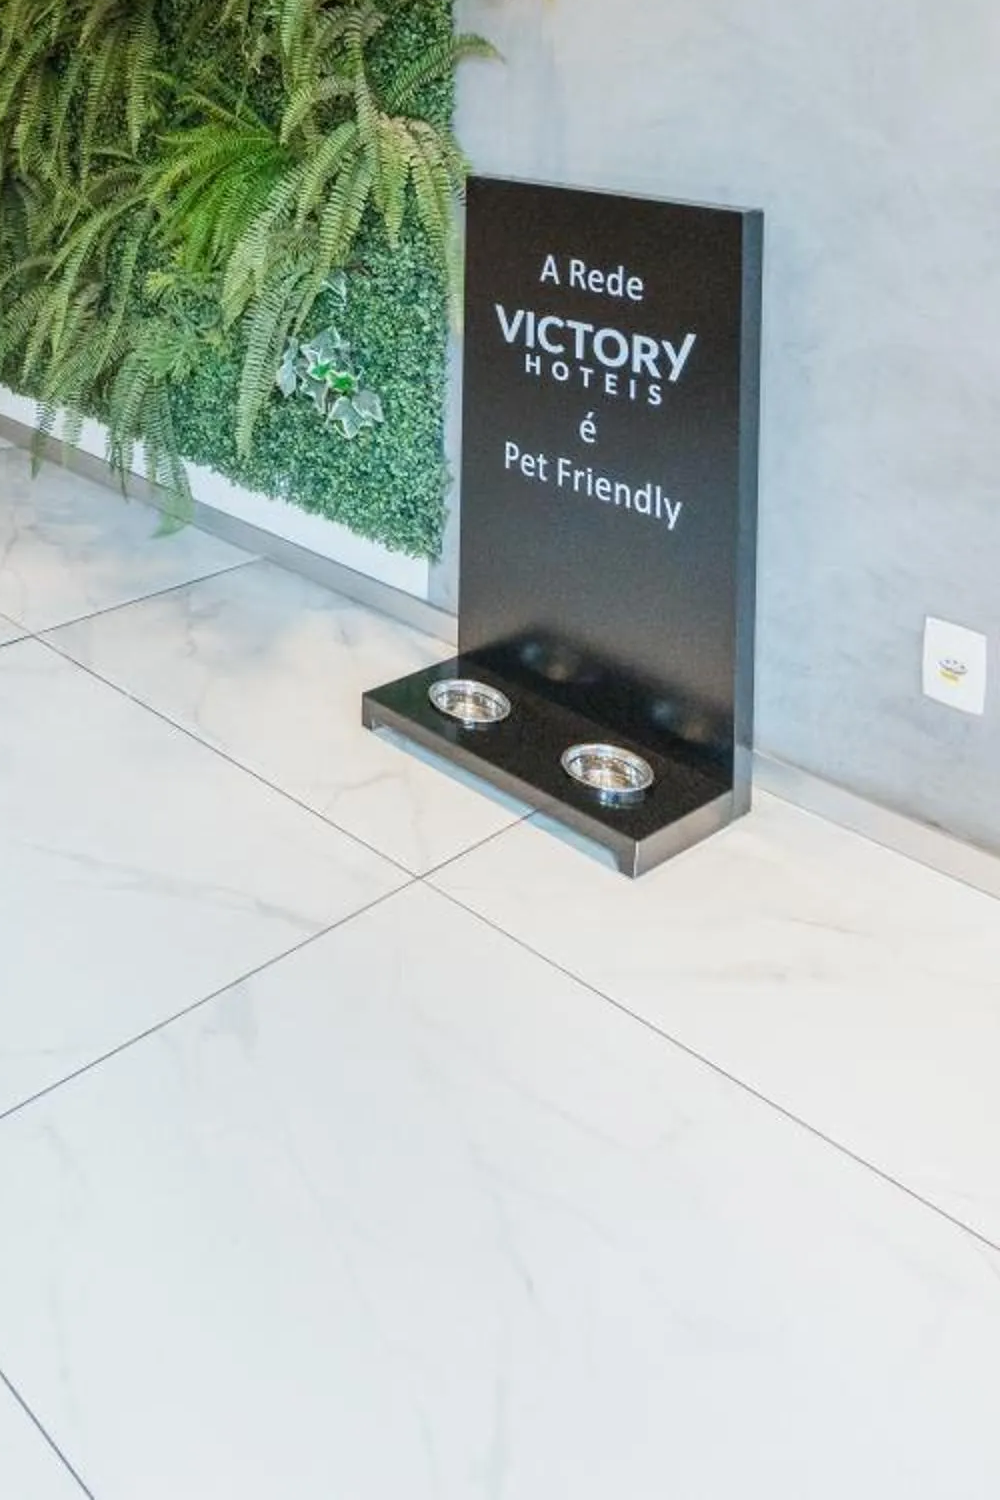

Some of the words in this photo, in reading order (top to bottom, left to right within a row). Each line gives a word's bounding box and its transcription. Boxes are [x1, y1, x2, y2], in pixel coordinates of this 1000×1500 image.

[540, 254, 560, 285] A
[569, 259, 645, 301] Rede
[495, 303, 697, 382] VICTORY
[525, 353, 663, 406] HOTEIS
[579, 411, 597, 443] é
[505, 441, 548, 482] Pet
[557, 457, 683, 531] Friendly
